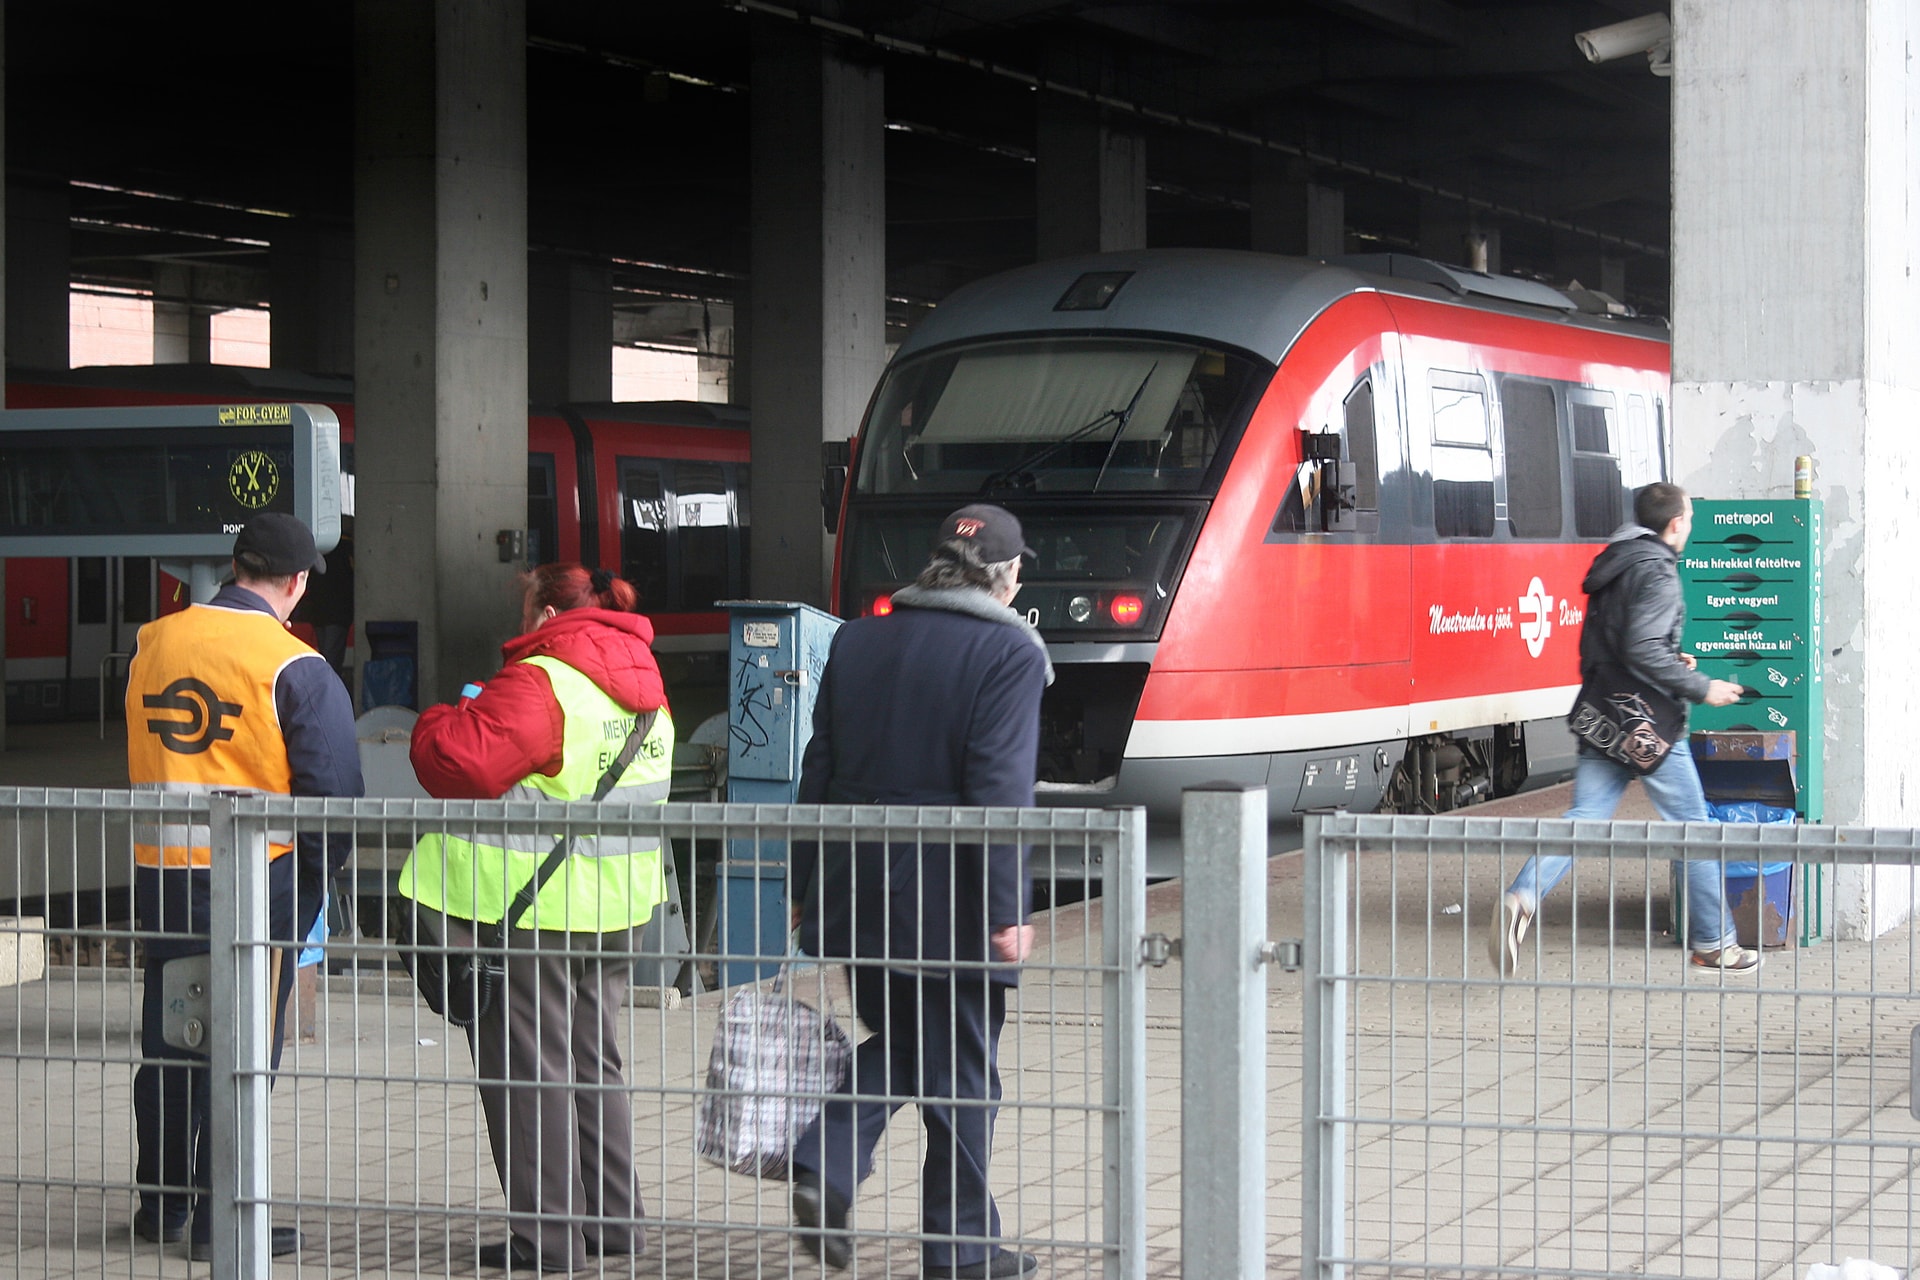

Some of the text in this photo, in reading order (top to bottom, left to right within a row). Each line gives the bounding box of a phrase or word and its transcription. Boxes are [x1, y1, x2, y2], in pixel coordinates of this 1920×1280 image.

[236, 405, 289, 420] FOK-GYEM
[1713, 512, 1774, 527] metropol
[1685, 557, 1801, 569] Friss hírekkel feltöltve
[1706, 595, 1779, 608] Egyet vegyen!
[1813, 513, 1822, 684] metropol
[1429, 604, 1487, 635] Menetrenden
[1723, 631, 1763, 642] Legalsót
[1695, 641, 1747, 652] egyenesen
[1749, 640, 1777, 650] húzza
